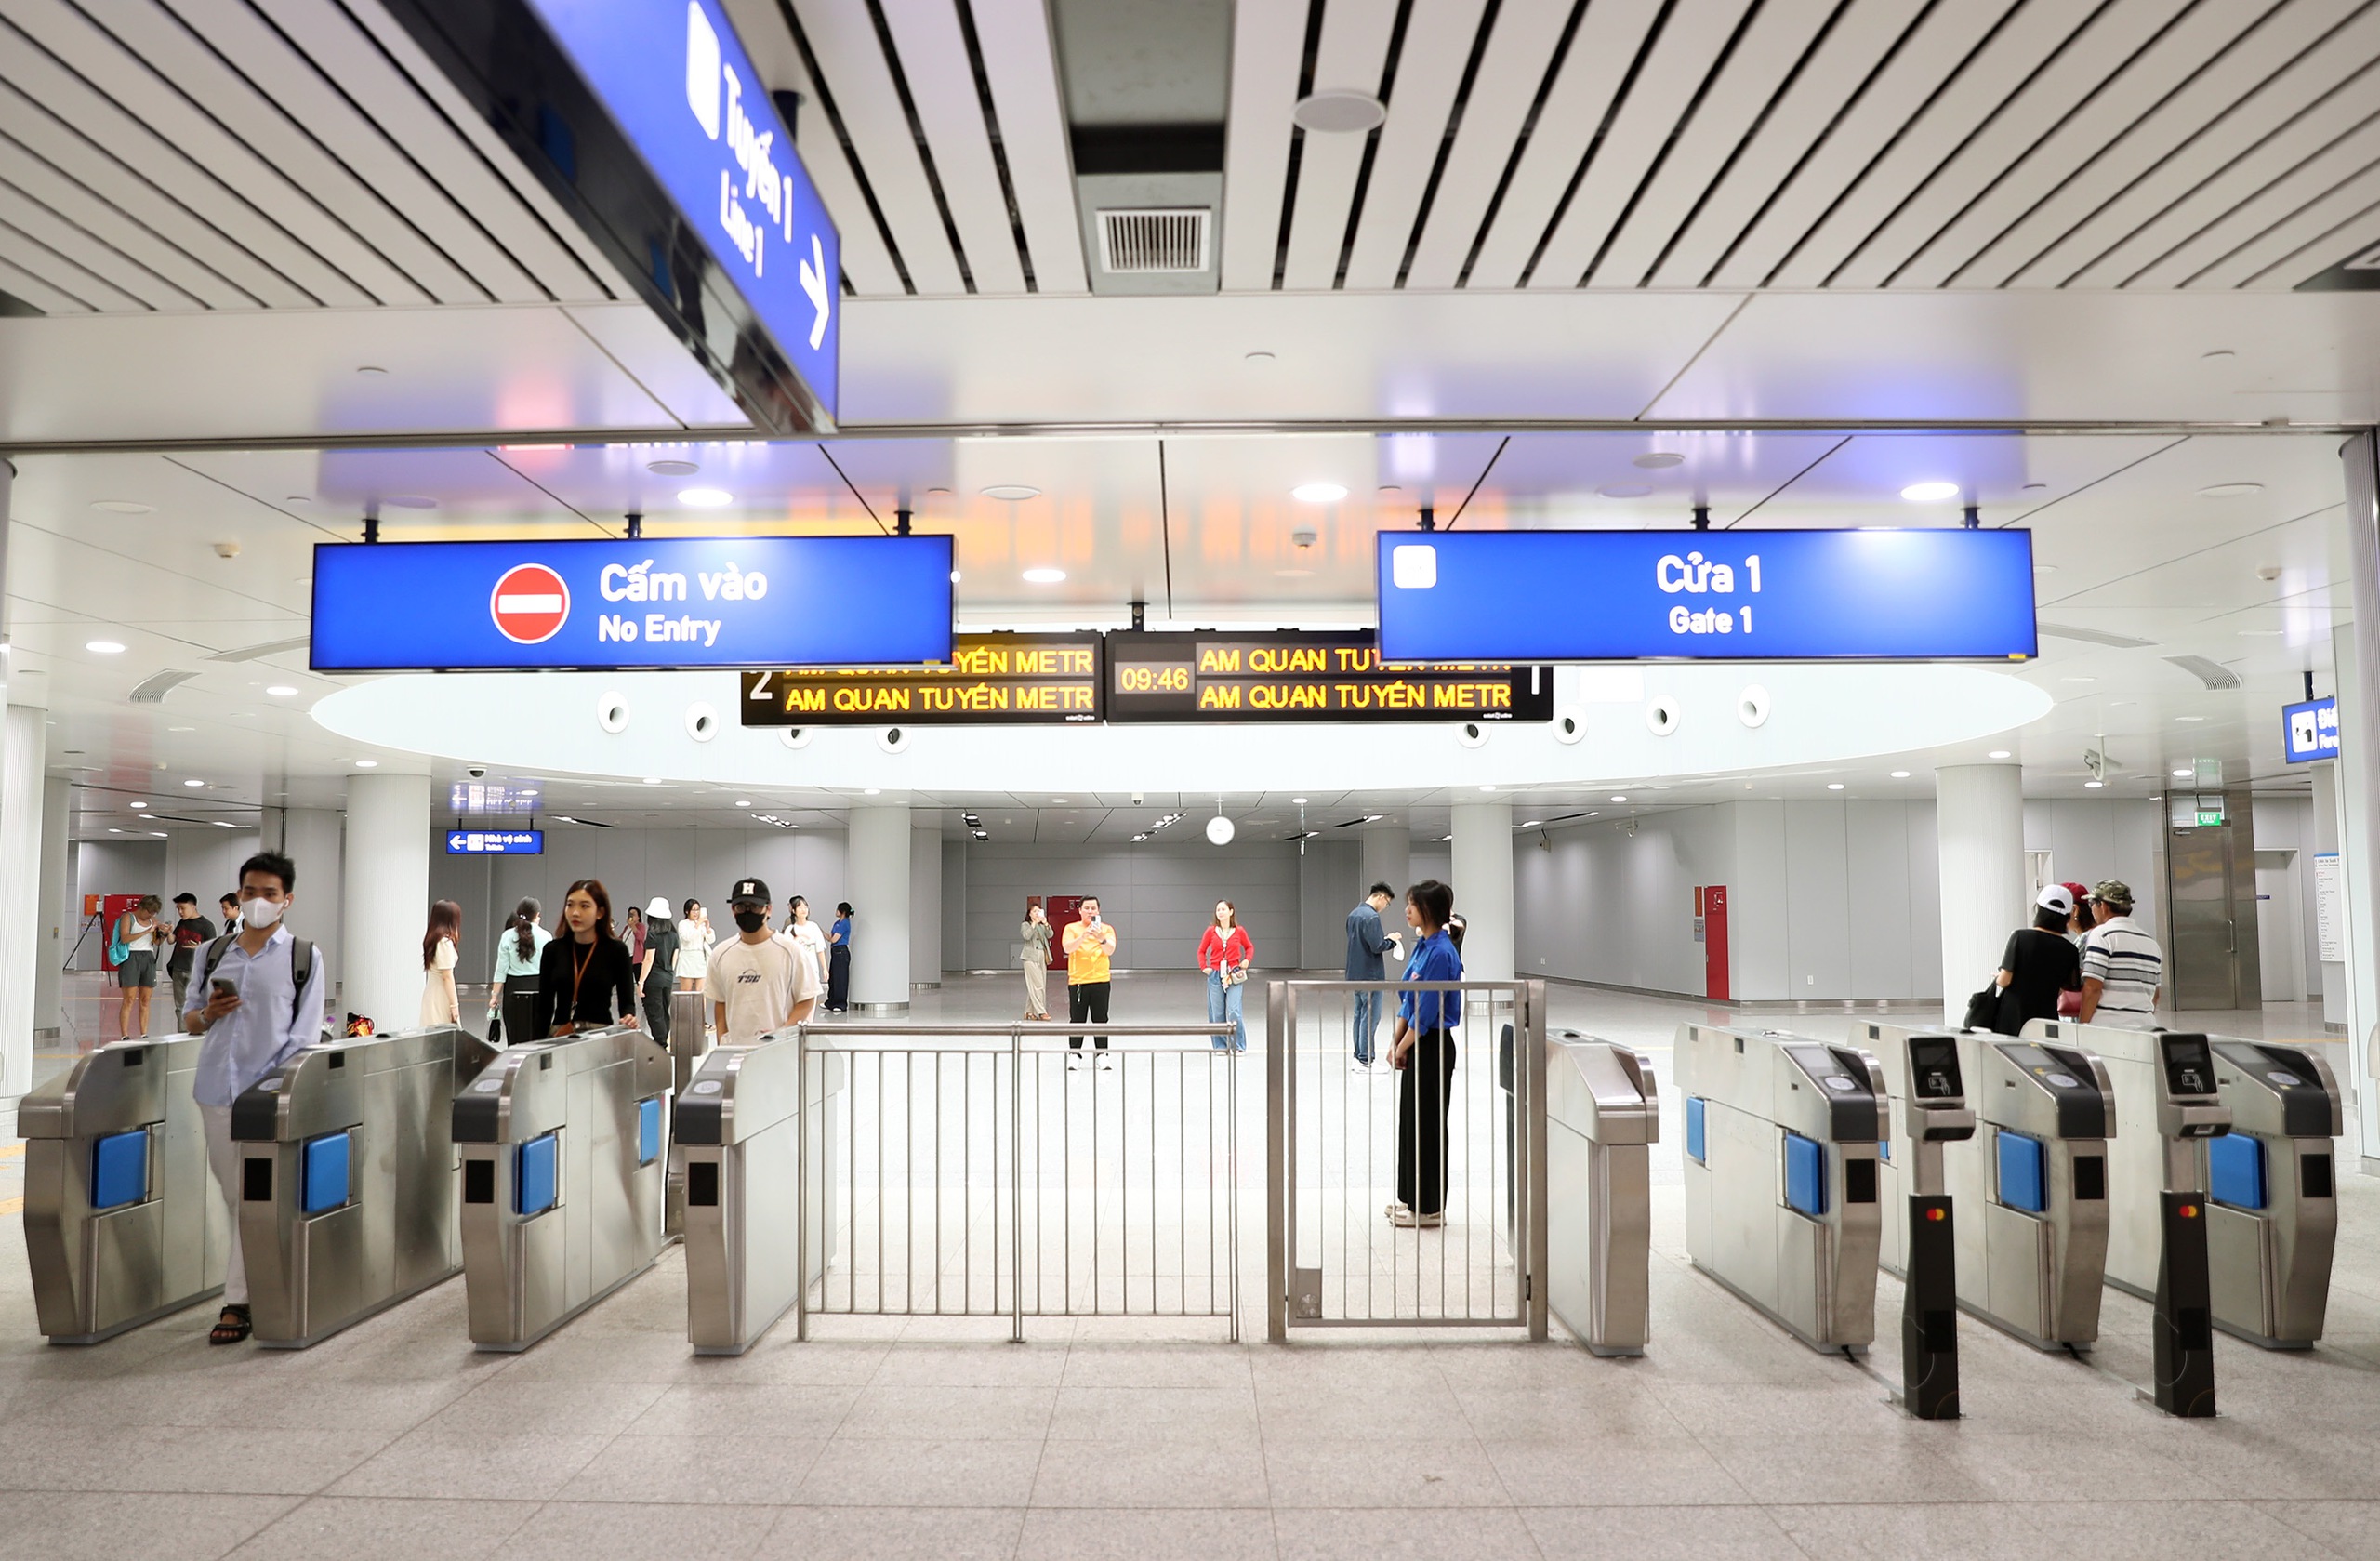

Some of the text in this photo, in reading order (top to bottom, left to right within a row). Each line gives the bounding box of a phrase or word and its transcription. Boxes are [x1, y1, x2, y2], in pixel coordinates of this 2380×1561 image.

[783, 175, 793, 244] 1
[720, 169, 764, 278] Line 1
[600, 559, 768, 602] Cấm vào
[1656, 551, 1761, 593] Cửa 1
[598, 614, 721, 647] No Entry
[1669, 605, 1752, 634] Gate 1
[1015, 650, 1094, 674] METR
[1199, 648, 1241, 672] AM
[1249, 648, 1328, 673] QUAN
[1120, 668, 1189, 691] 09:46
[785, 688, 826, 711] AM
[833, 687, 910, 712] QUAN
[1016, 686, 1094, 709] METR
[1199, 685, 1241, 708] AM
[1249, 684, 1328, 709] QUAN
[1433, 684, 1512, 708] METR
[742, 882, 755, 895] H
